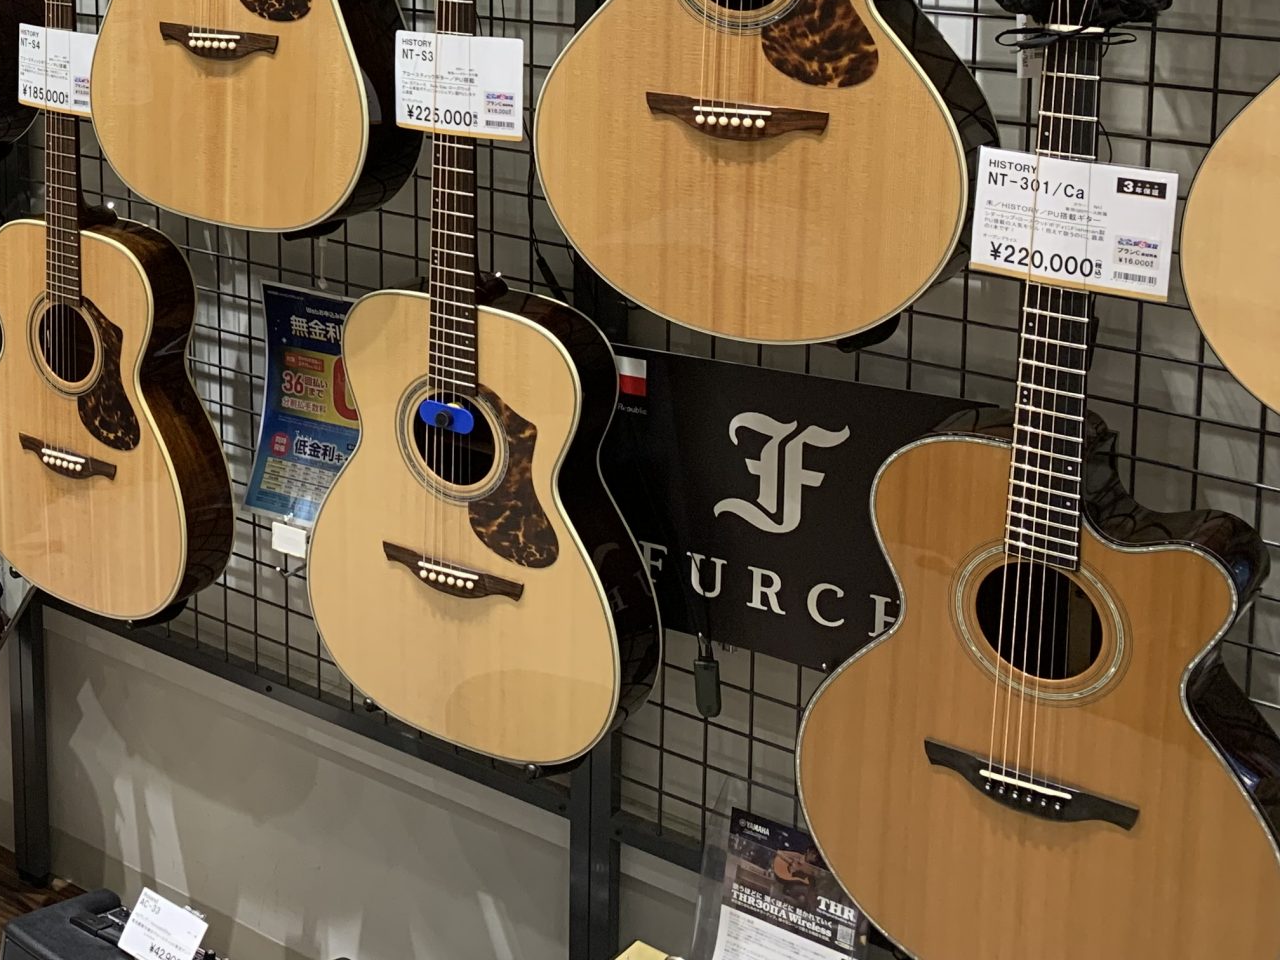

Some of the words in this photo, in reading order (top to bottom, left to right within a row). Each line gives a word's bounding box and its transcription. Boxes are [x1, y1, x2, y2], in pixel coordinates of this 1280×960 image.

[21, 37, 40, 50] NT-S4
[402, 38, 432, 48] HISTORY
[402, 48, 434, 62] NT-S3
[407, 103, 473, 127] ¥225,000
[989, 159, 1037, 174] HISTORY
[988, 171, 1085, 200] NT-301/Ca
[990, 241, 1094, 277] ¥220,000
[282, 370, 305, 395] 36
[746, 821, 770, 836] YAMAHA
[817, 896, 856, 923] THR
[788, 913, 832, 937] Wireless
